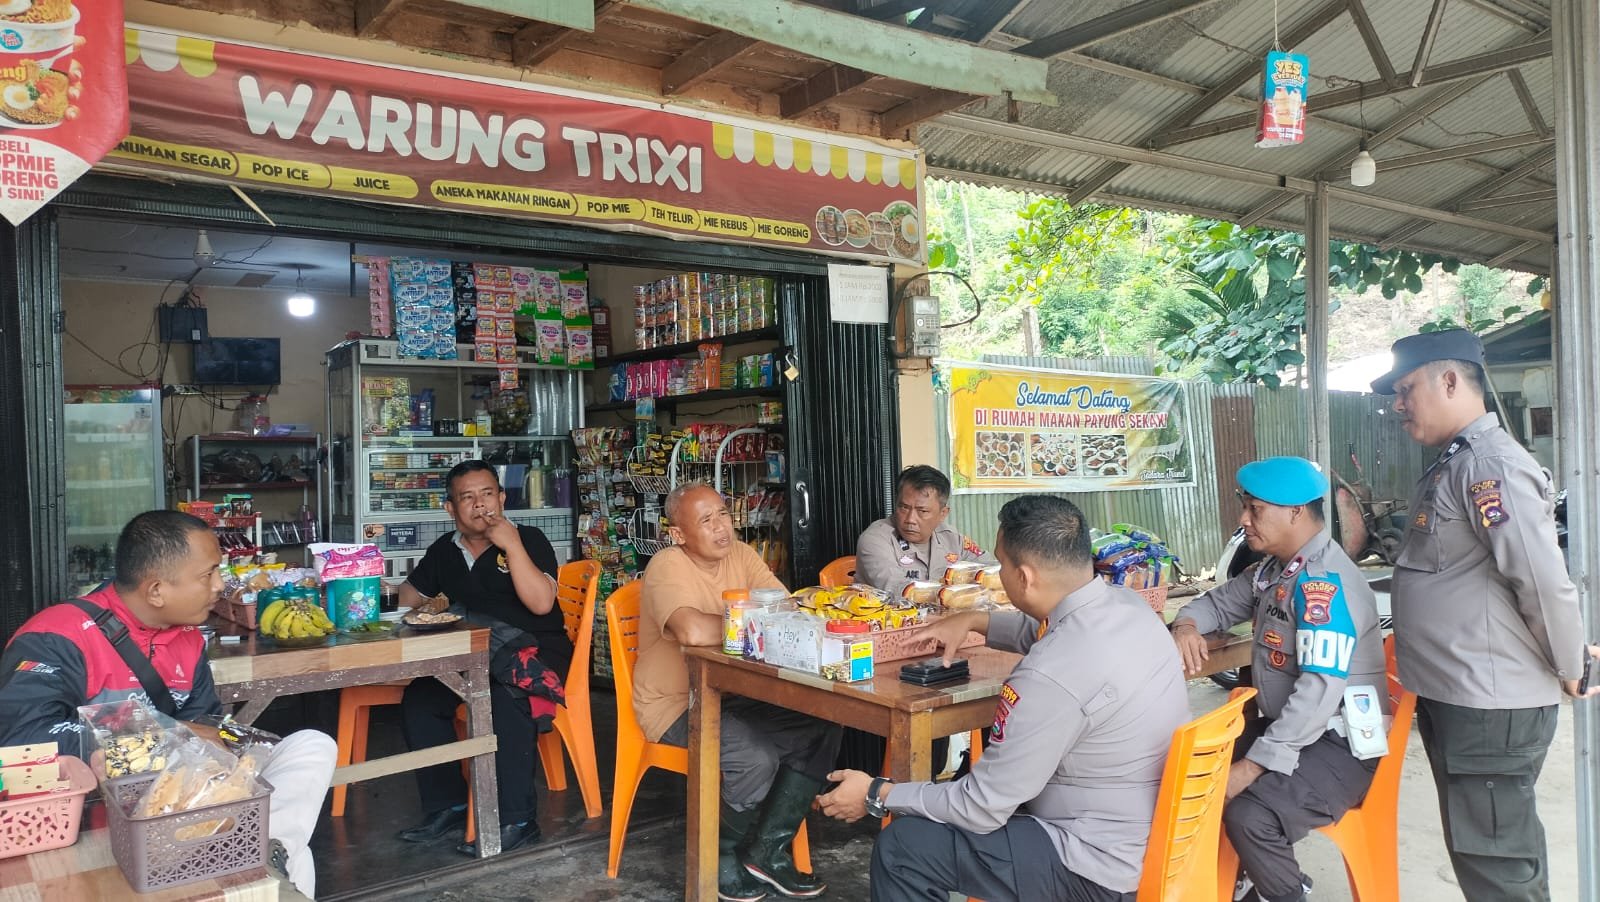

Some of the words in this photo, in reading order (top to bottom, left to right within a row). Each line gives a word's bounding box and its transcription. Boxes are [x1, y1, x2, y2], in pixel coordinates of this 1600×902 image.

[0, 65, 27, 83] ng
[238, 74, 546, 173] WARUNG
[561, 125, 702, 194] TRIXI
[113, 141, 177, 161] NUMAN
[180, 150, 232, 171] SEGAR
[252, 162, 283, 178] POP
[286, 166, 309, 181] ICE
[352, 176, 390, 190] JUICE
[8, 188, 45, 201] SINI!
[435, 185, 475, 198] ANEKA
[476, 188, 530, 205] MAKANAN
[532, 194, 571, 209] RINGAN
[587, 201, 609, 213] POP
[612, 203, 631, 214] MIE
[651, 207, 666, 219] TEH
[667, 211, 694, 225] TELUR
[703, 217, 719, 228] MIE
[720, 218, 748, 231] REBUS
[757, 223, 772, 234] MIE
[773, 225, 809, 239] GORENG
[1016, 382, 1072, 408] Selamat
[1073, 385, 1131, 412] Datang
[975, 409, 988, 427] DI
[991, 409, 1035, 428] RUMAH
[1039, 411, 1081, 429] MAKAN
[1084, 412, 1126, 429] PAYUNG
